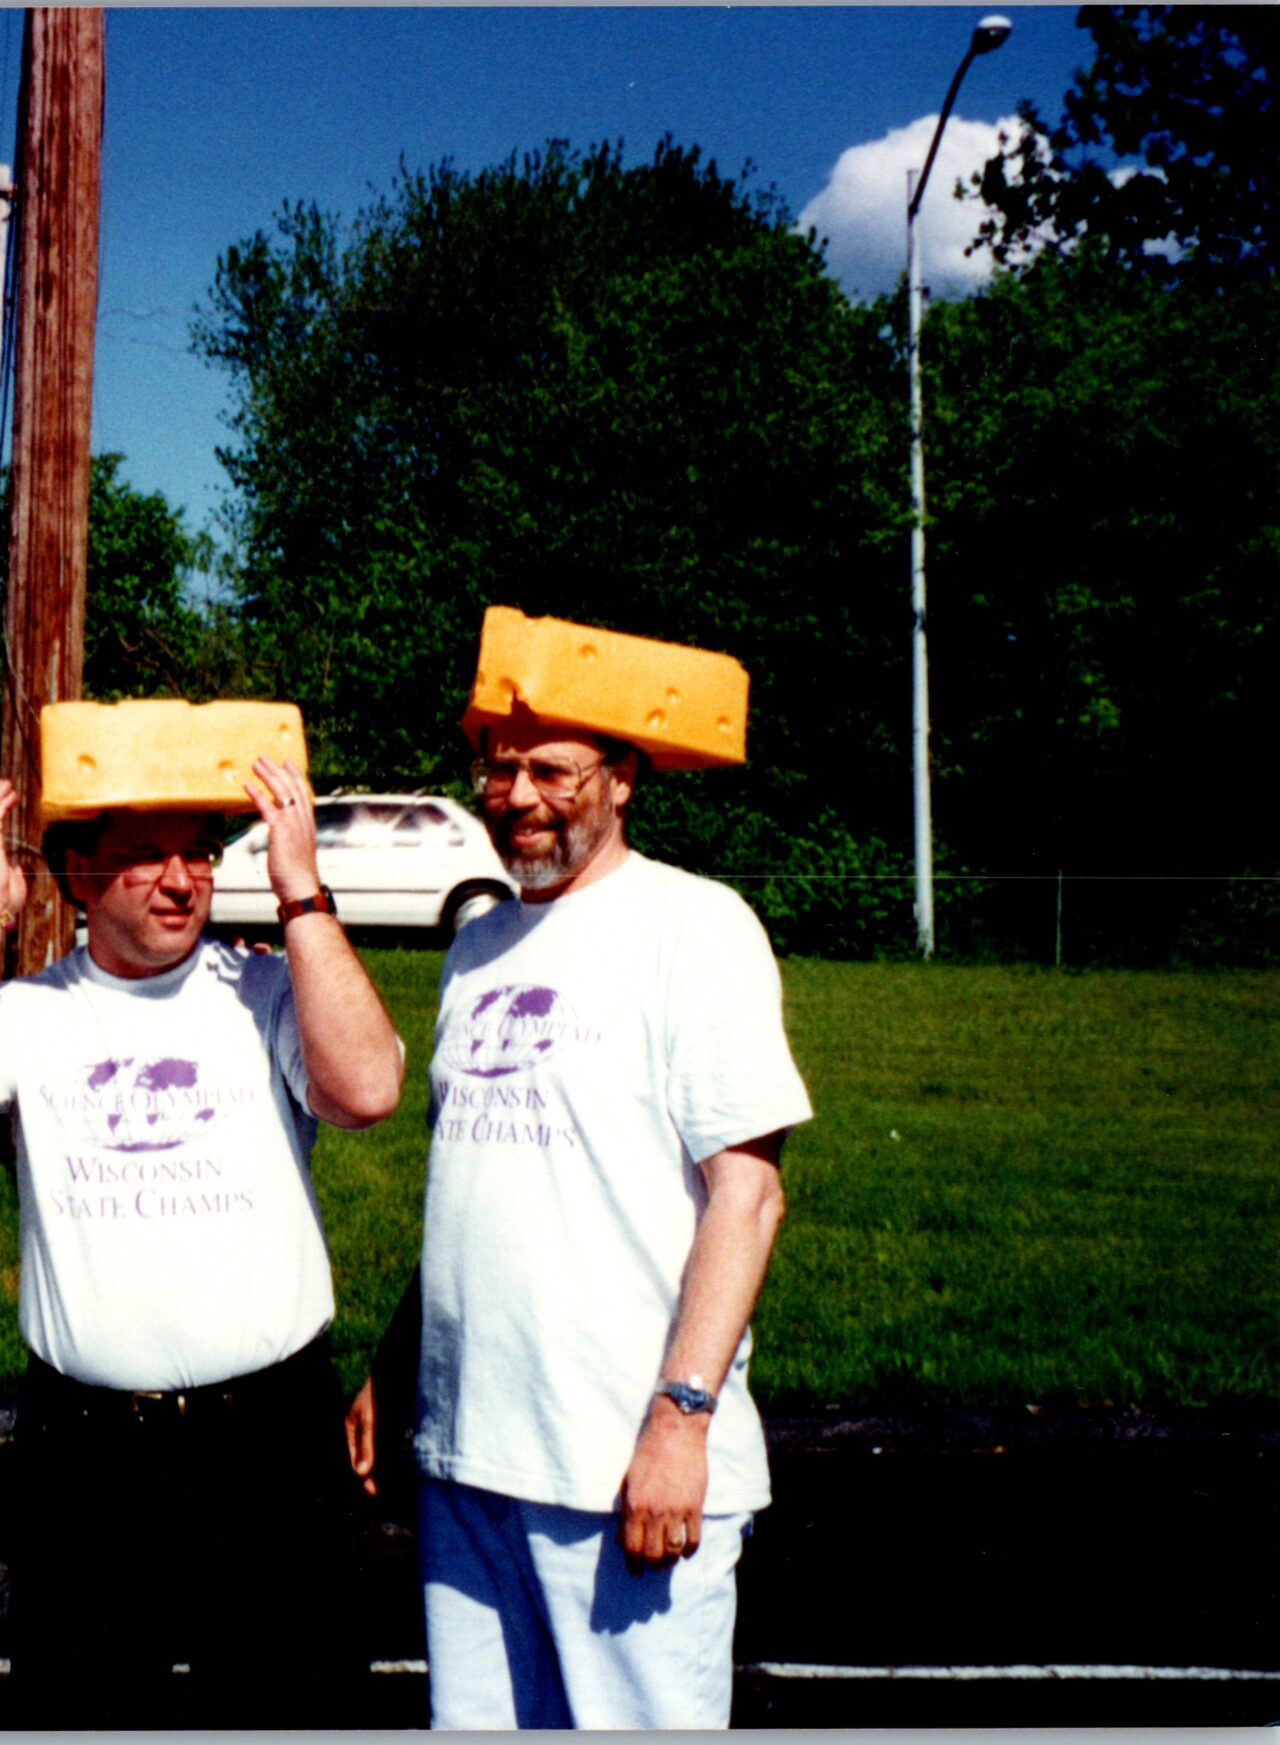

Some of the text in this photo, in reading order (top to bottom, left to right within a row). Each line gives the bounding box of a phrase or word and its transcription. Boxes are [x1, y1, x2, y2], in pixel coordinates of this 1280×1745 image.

[66, 1156, 222, 1183] WISCONSIN
[50, 1188, 253, 1219] STATE CHAMPS
